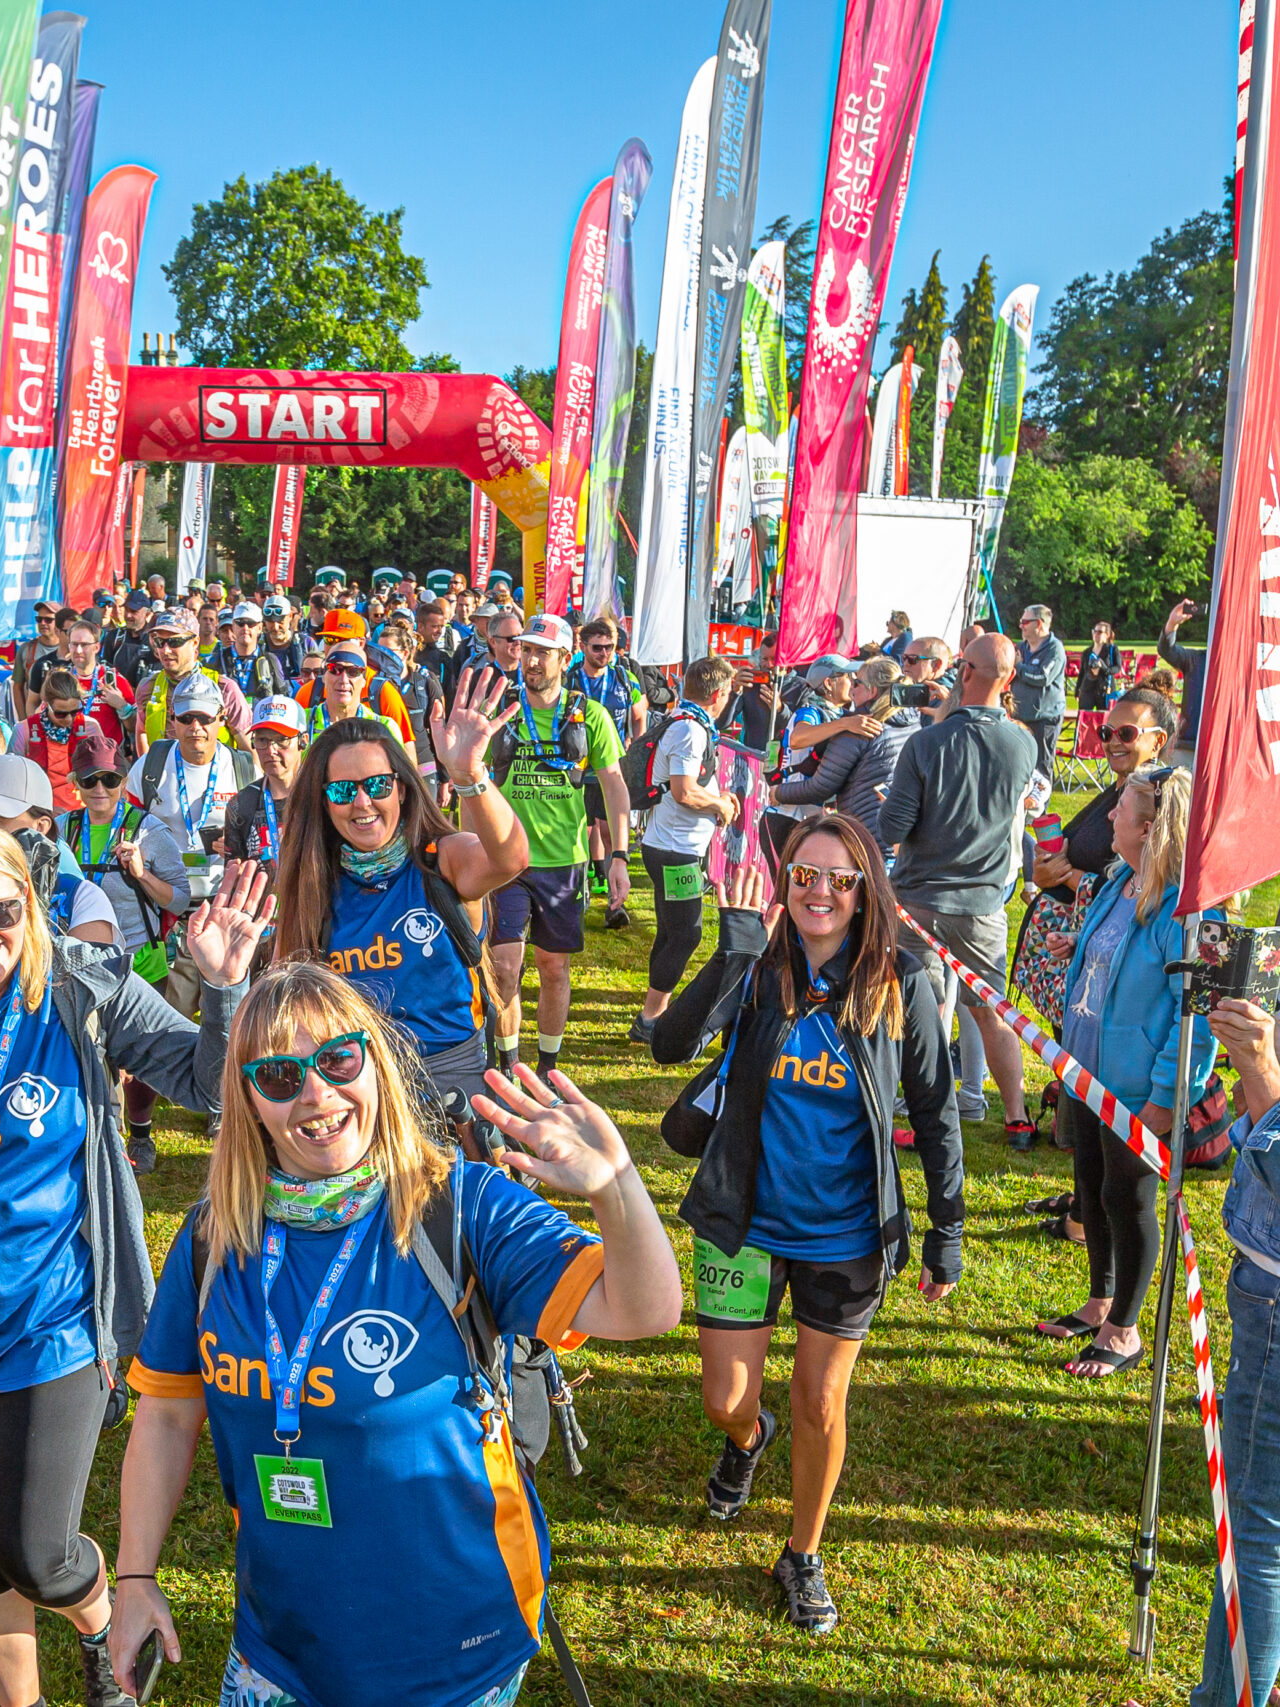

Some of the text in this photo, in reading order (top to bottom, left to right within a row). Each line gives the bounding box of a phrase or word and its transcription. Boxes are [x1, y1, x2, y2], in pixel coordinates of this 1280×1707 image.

[715, 73, 737, 202] CANCER UK
[729, 80, 749, 198] PROSTATE
[844, 62, 891, 236] RESEARCH
[829, 92, 863, 230] CANCER
[895, 133, 915, 219] beat cancer
[858, 195, 878, 240] UK
[582, 223, 599, 274] NOW
[591, 229, 608, 310] CANCER
[3, 57, 64, 606] HELP for HEROES
[701, 287, 718, 379] CANCER
[710, 294, 728, 404] PROSTATE
[80, 335, 106, 447] Heartbreak
[566, 361, 583, 410] NOW
[765, 345, 788, 413] YOURSELF
[205, 391, 381, 441] START
[574, 365, 596, 443] CANCER
[653, 383, 668, 460] JOIN US.
[669, 386, 680, 429] FIND
[68, 409, 84, 449] Beat
[90, 373, 122, 478] Forever
[285, 478, 298, 503] RUN
[281, 512, 294, 537] JOG
[277, 554, 291, 581] WALK
[476, 556, 489, 585] WALK
[513, 762, 533, 773] WAY
[516, 775, 563, 786] CHALLENGE
[511, 790, 536, 801] 2021
[675, 874, 697, 886] 1001
[329, 936, 403, 974] ands
[770, 1051, 847, 1089] nds
[265, 1258, 276, 1281] 2022
[328, 1262, 343, 1284] 2022
[698, 1263, 744, 1288] 2076
[707, 1287, 725, 1296] Sands
[714, 1304, 761, 1317] Full Cont. (W)
[199, 1331, 337, 1408] Sans
[289, 1362, 301, 1385] 2022
[277, 1478, 306, 1490] COTSWOLD
[281, 1466, 300, 1475] 2022
[274, 1508, 323, 1522] EVENT PASS
[461, 1635, 483, 1650] MAX
